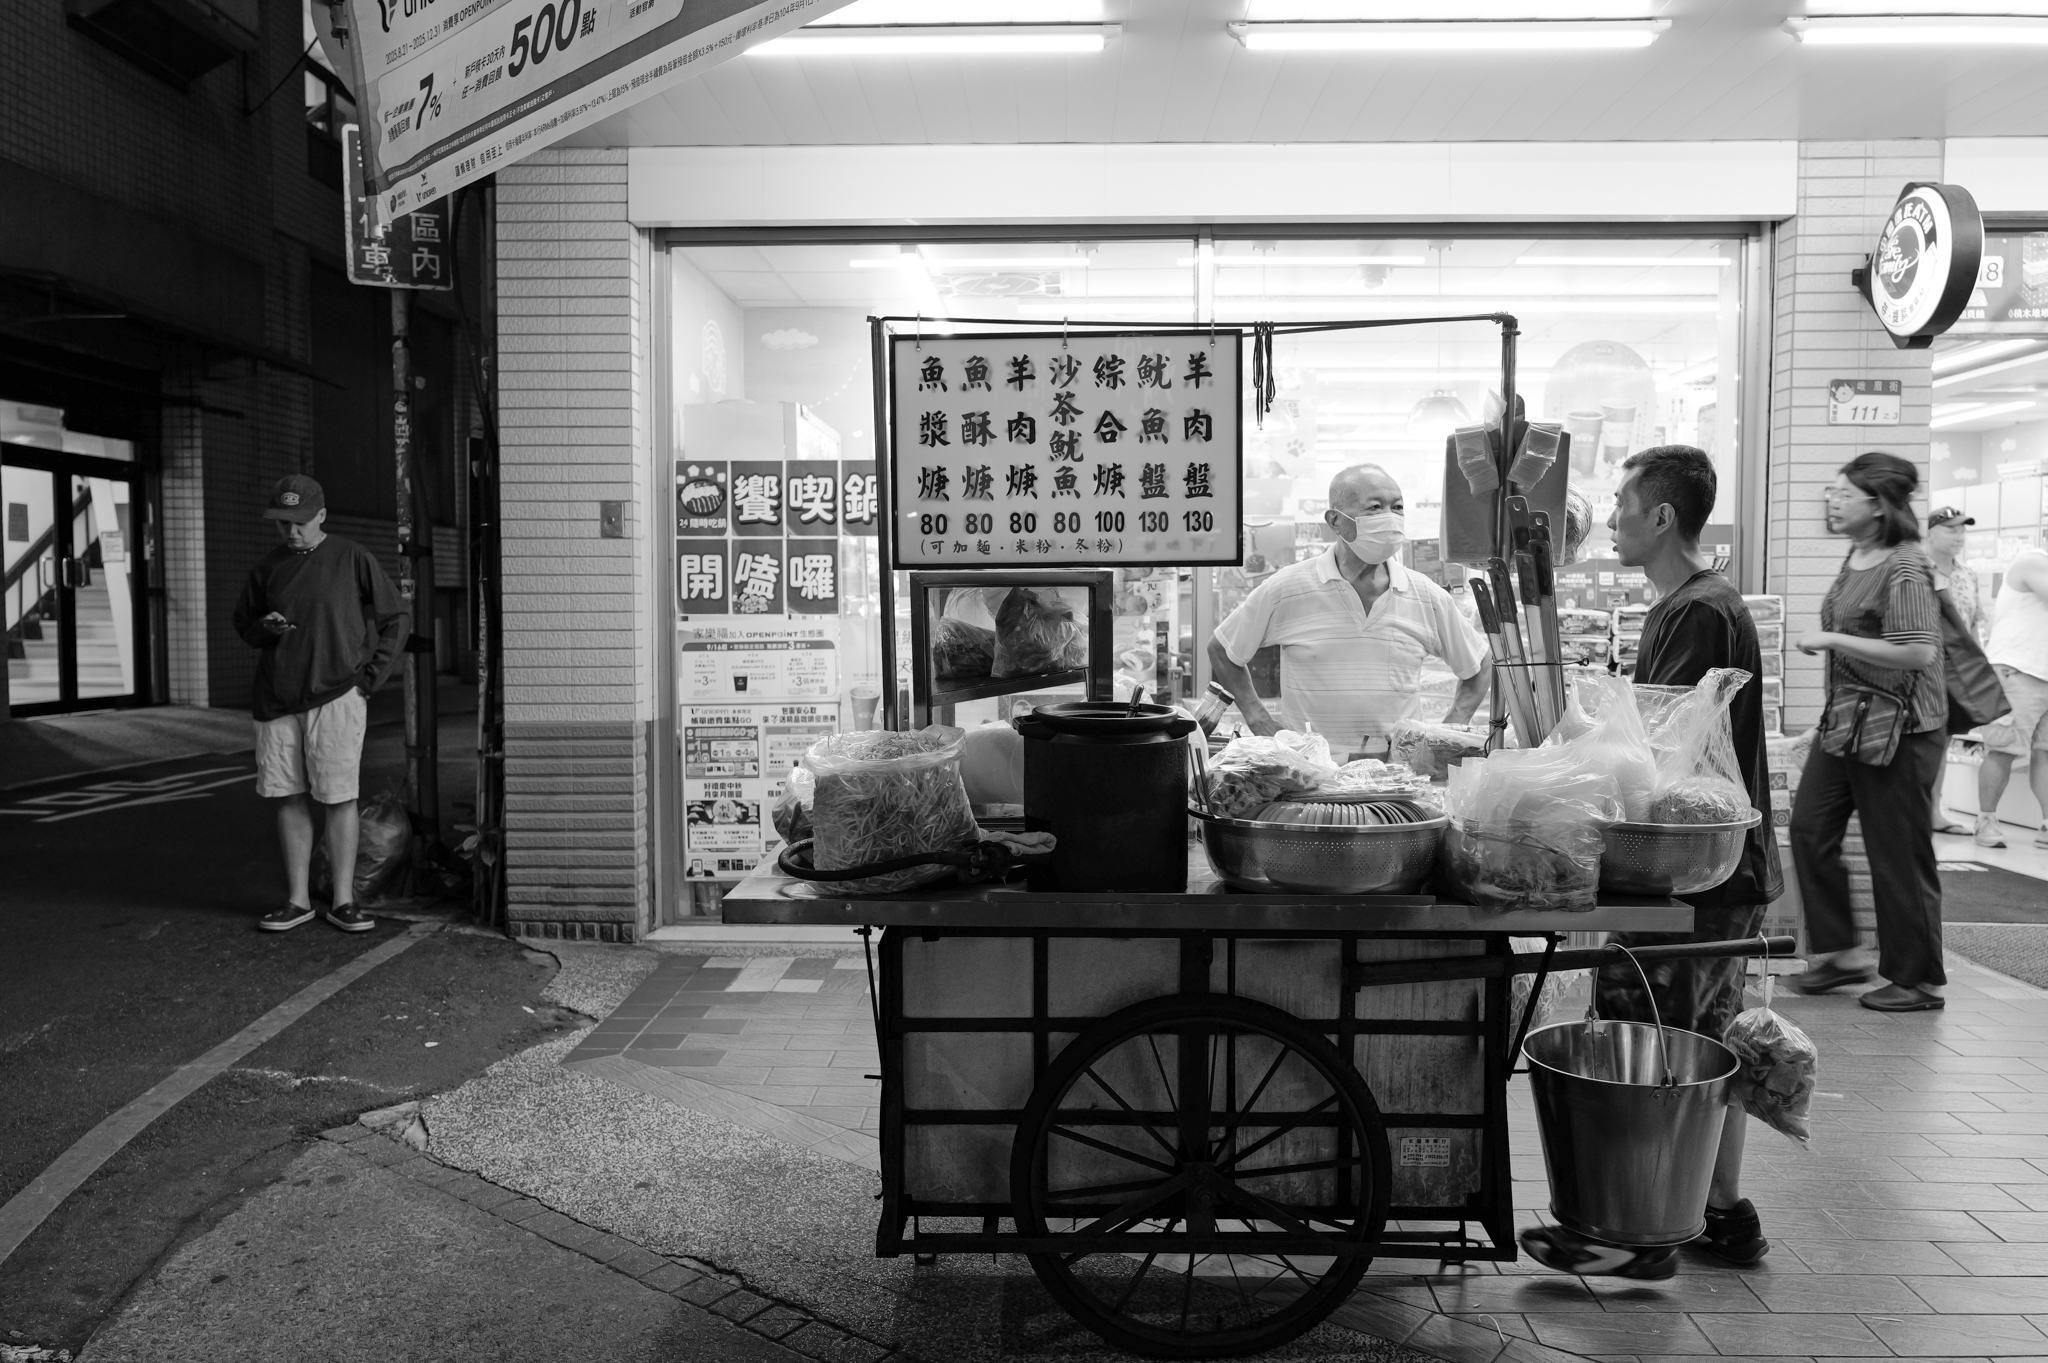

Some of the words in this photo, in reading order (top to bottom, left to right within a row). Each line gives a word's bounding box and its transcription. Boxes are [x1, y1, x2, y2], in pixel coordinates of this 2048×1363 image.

[416, 72, 443, 131] 7%
[508, 0, 582, 78] 500
[580, 7, 597, 38] 點
[409, 211, 441, 280] 區內
[960, 354, 998, 502] 魚酥焿
[1005, 354, 1038, 500] 羊肉焿
[1048, 354, 1085, 500] 沙茶魷魚
[1092, 354, 1128, 500] 綜合焿
[1136, 353, 1173, 501] 魷魚盤
[1182, 351, 1214, 500] 羊肉盤
[1851, 405, 1879, 421] 111
[921, 513, 948, 535] 80
[965, 513, 993, 535] 80
[1009, 512, 1037, 534] 80
[1053, 511, 1081, 534] 80
[1094, 511, 1125, 533] 100
[1138, 511, 1169, 533] 130
[1182, 511, 1214, 533] 130
